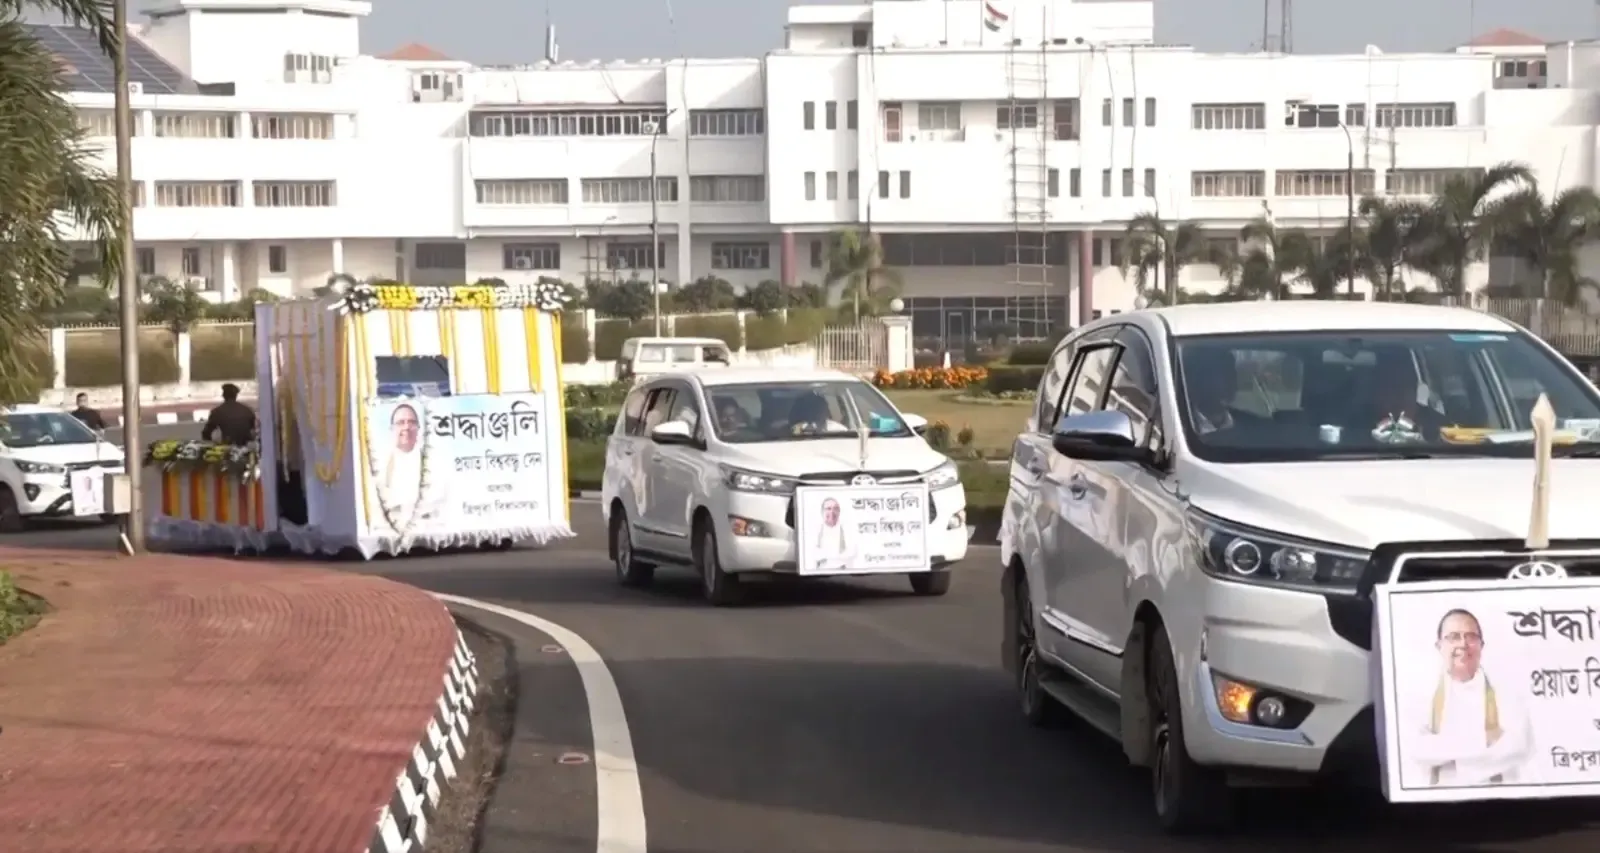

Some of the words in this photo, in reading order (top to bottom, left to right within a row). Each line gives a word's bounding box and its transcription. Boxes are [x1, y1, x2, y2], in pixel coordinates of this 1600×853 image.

[432, 400, 539, 441] শ্রদ্ধাঞ্জলি
[851, 491, 920, 512] শ্রদ্ধাঞ্জলি
[1505, 606, 1600, 643] শ্রদ্ধা
[1531, 668, 1581, 698] প্রয়াত
